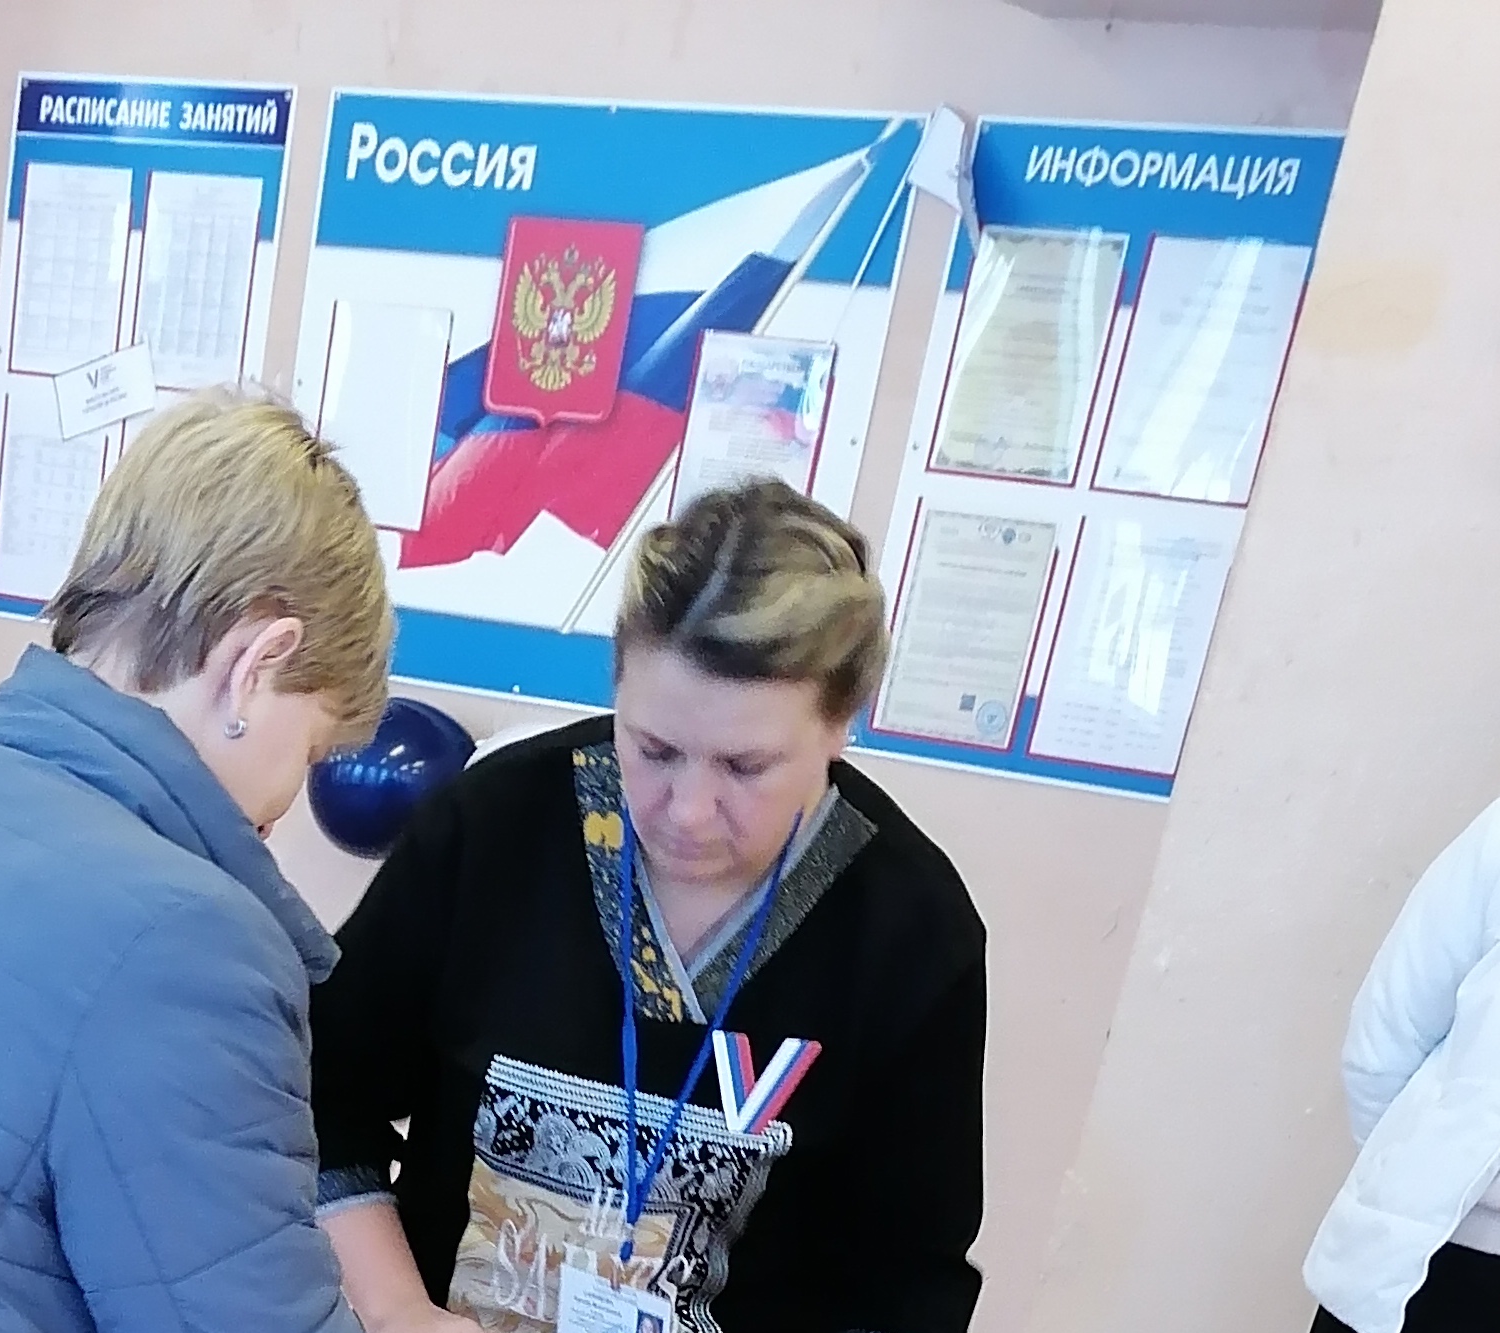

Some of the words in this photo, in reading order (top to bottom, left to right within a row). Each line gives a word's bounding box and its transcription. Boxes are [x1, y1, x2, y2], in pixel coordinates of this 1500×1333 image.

[39, 95, 172, 129] РАСПИСАНИЕ
[179, 98, 278, 135] ЗАНЯТИЙ
[346, 121, 538, 191] Россия
[1024, 144, 1301, 200] ИНФОРМАЦИЯ
